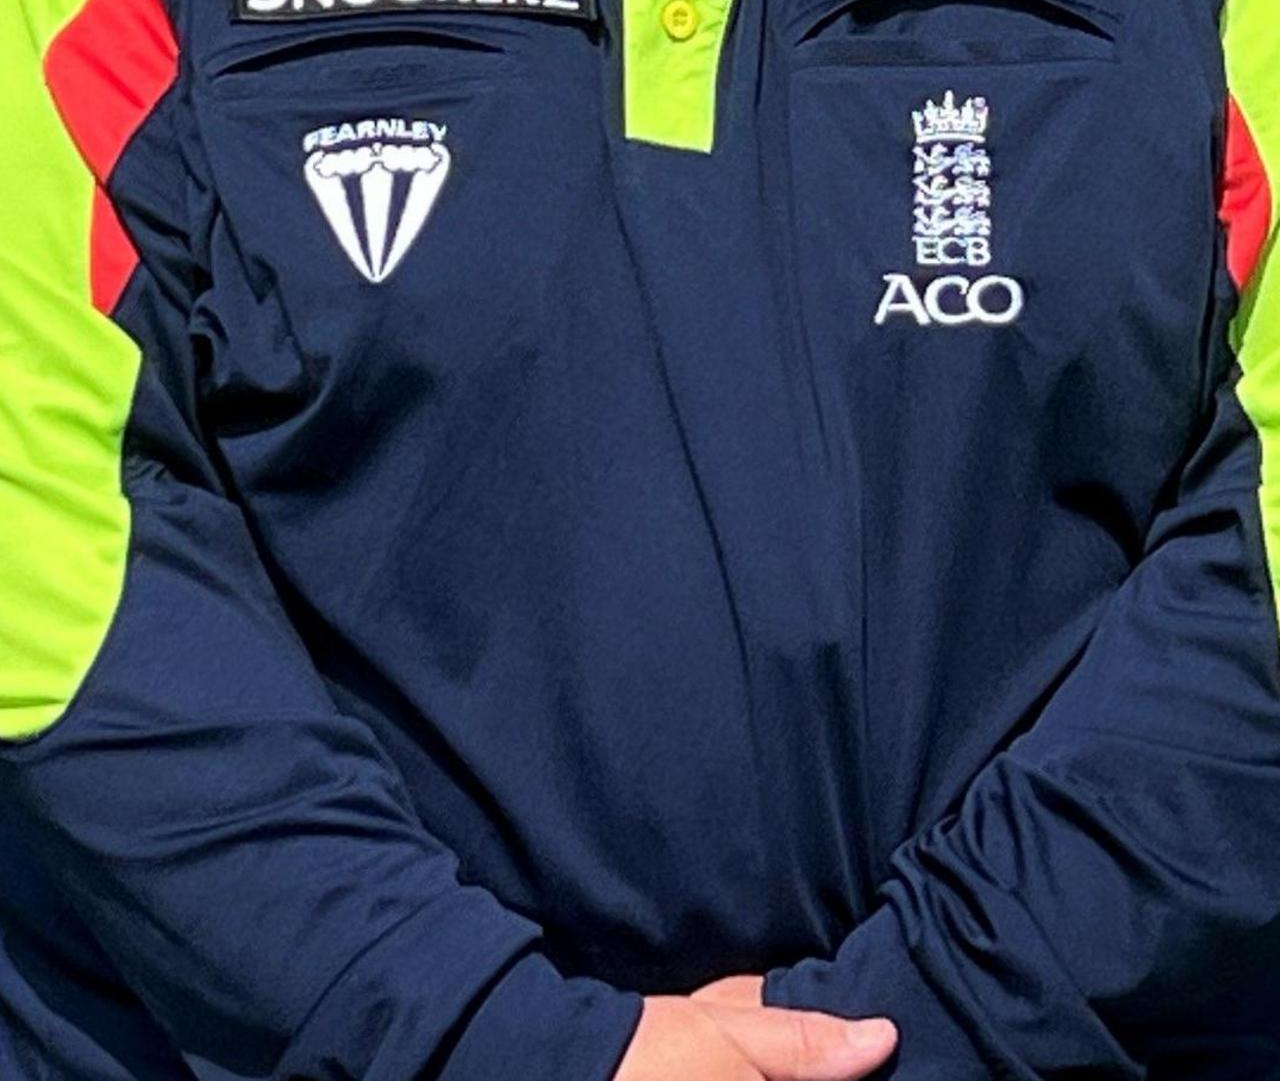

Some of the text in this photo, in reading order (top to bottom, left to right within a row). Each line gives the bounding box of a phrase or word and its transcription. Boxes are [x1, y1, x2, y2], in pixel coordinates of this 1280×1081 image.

[302, 118, 447, 153] FEARNLEY
[912, 236, 992, 266] ECB
[873, 273, 1024, 326] ACO
